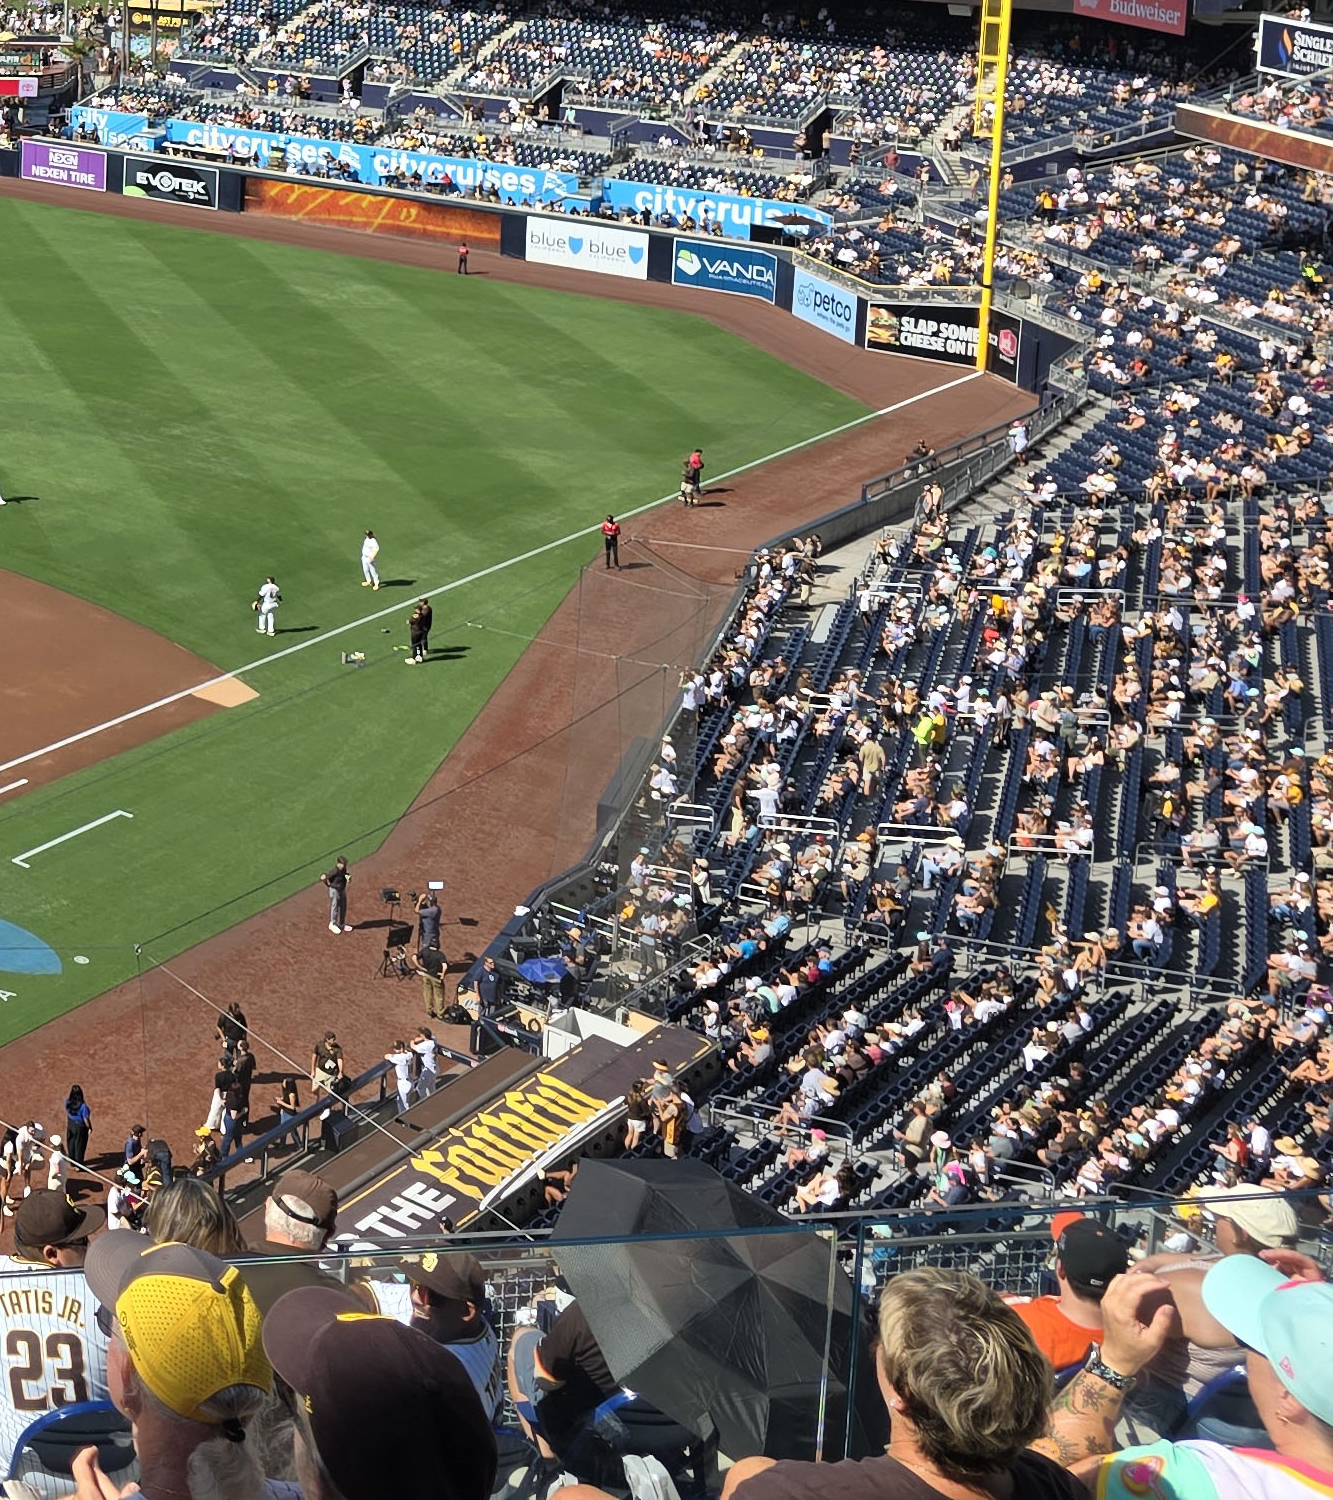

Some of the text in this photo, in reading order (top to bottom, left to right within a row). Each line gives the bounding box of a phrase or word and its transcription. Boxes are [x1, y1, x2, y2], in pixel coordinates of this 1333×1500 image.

[31, 164, 96, 185] NEXEN TIRE
[136, 171, 207, 195] EVOTEK
[530, 230, 627, 259] blue blue
[702, 256, 775, 284] VANDA
[813, 288, 852, 322] petco
[899, 331, 945, 352] CHEESE
[946, 339, 966, 355] ON
[900, 316, 938, 338] SLAP
[939, 321, 980, 344] SOME
[354, 1181, 457, 1238] THE
[56, 1295, 86, 1328] JR.
[5, 1329, 89, 1411] 23
